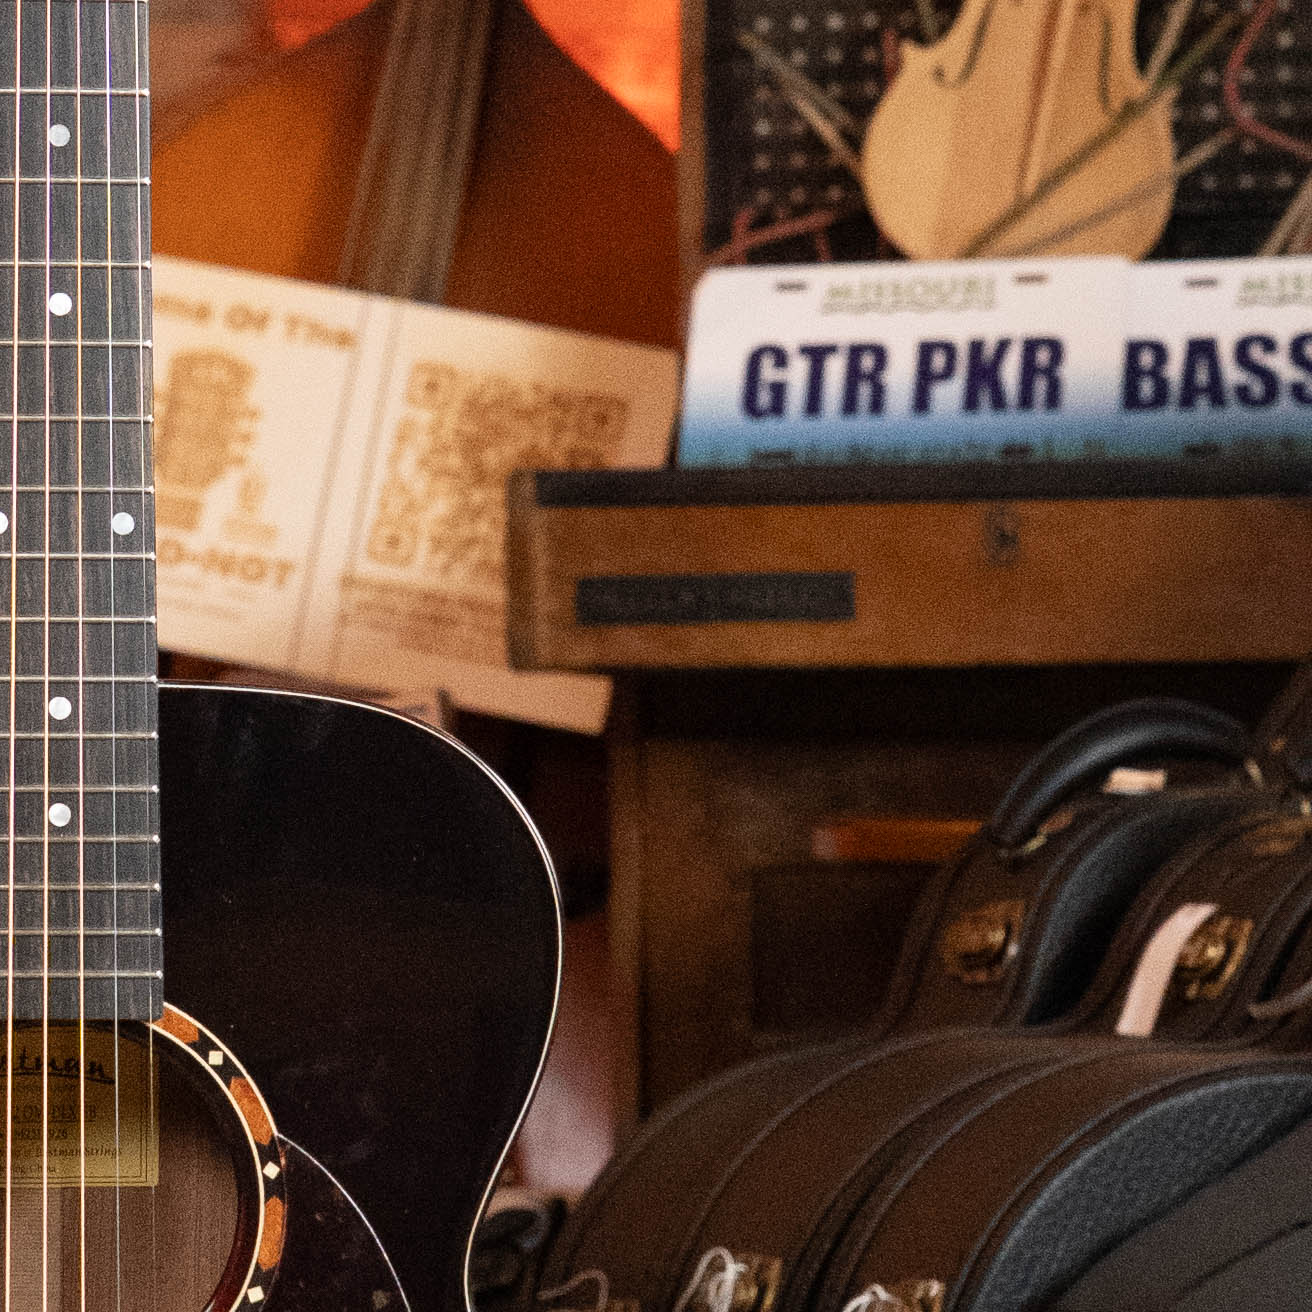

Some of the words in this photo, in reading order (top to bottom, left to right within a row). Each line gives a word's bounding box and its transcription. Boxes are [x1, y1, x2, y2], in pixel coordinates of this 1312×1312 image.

[741, 343, 890, 420] GTR
[911, 336, 1067, 415] PKR
[1120, 332, 1312, 412] BASS
[35, 1145, 81, 1158] Estman
